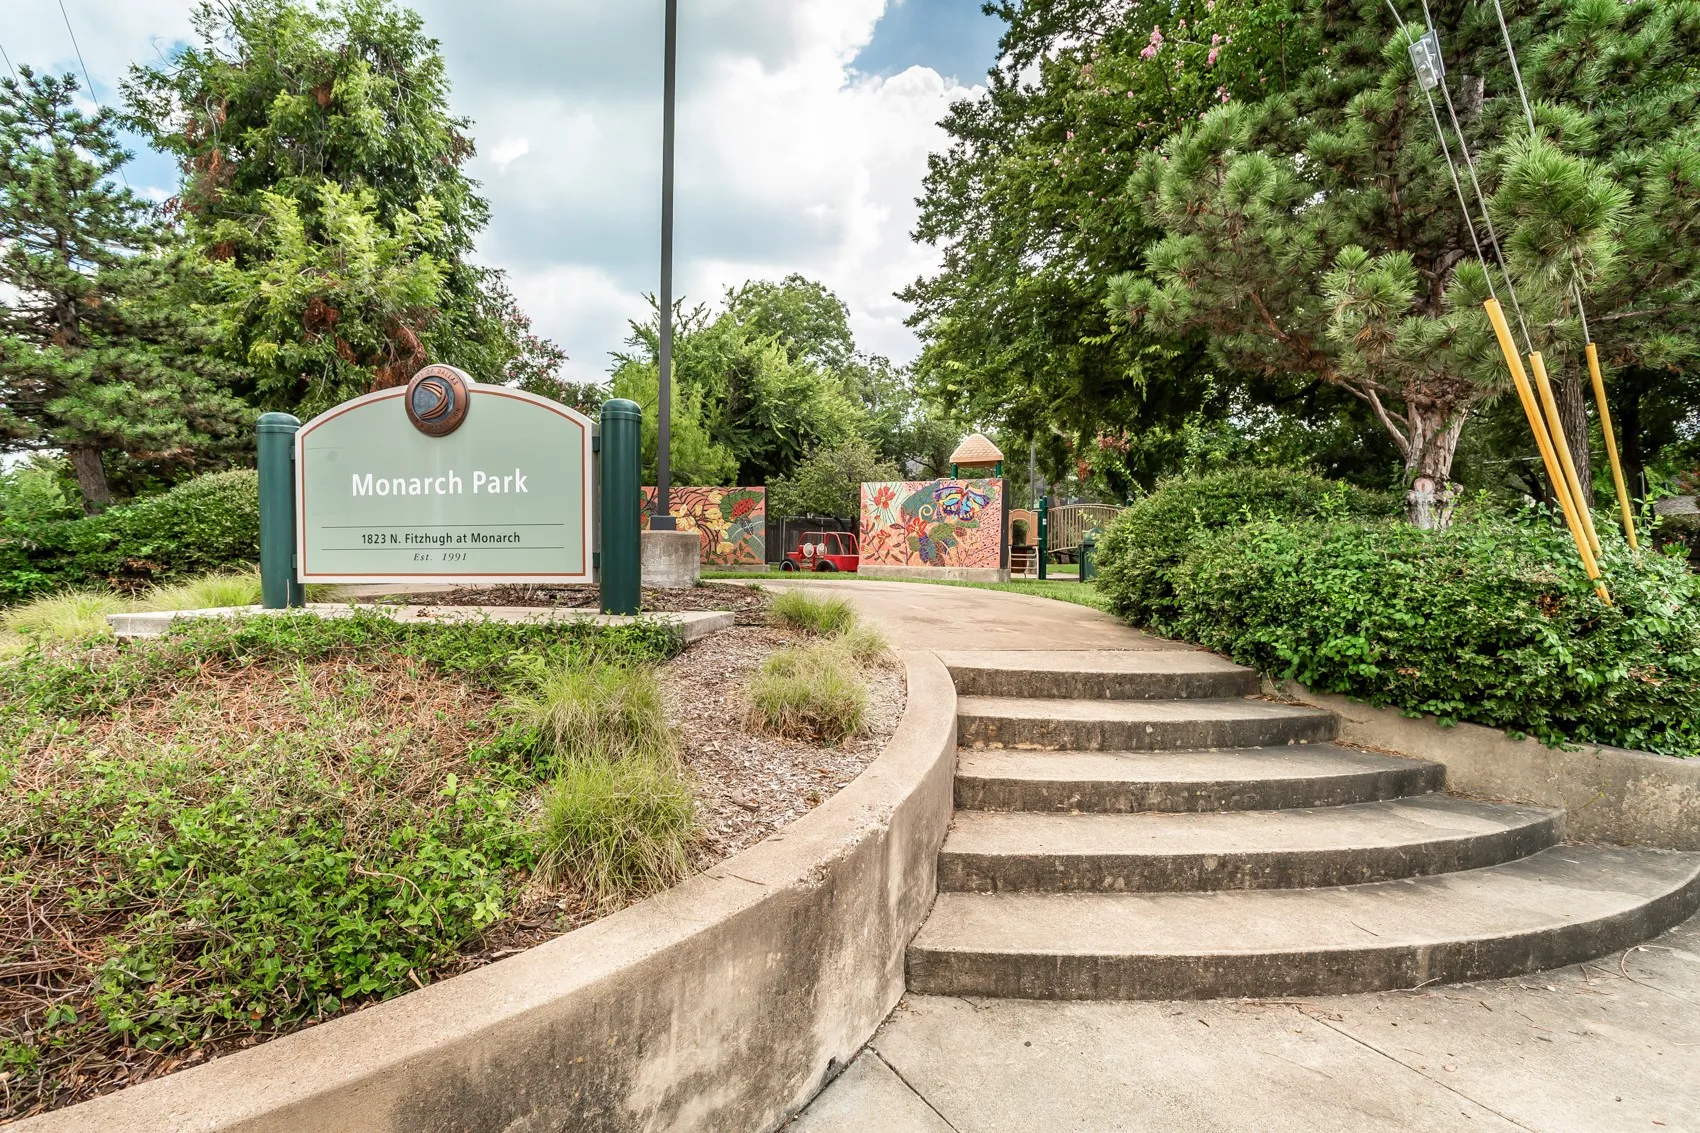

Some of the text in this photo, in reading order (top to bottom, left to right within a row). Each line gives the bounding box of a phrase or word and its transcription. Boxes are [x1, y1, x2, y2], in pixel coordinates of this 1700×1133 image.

[437, 368, 459, 386] DALLAS
[352, 468, 529, 497] Monarch Park
[361, 531, 521, 546] 1823 N. Fitzhugh at Monarch
[413, 552, 468, 562] Est. 1991
